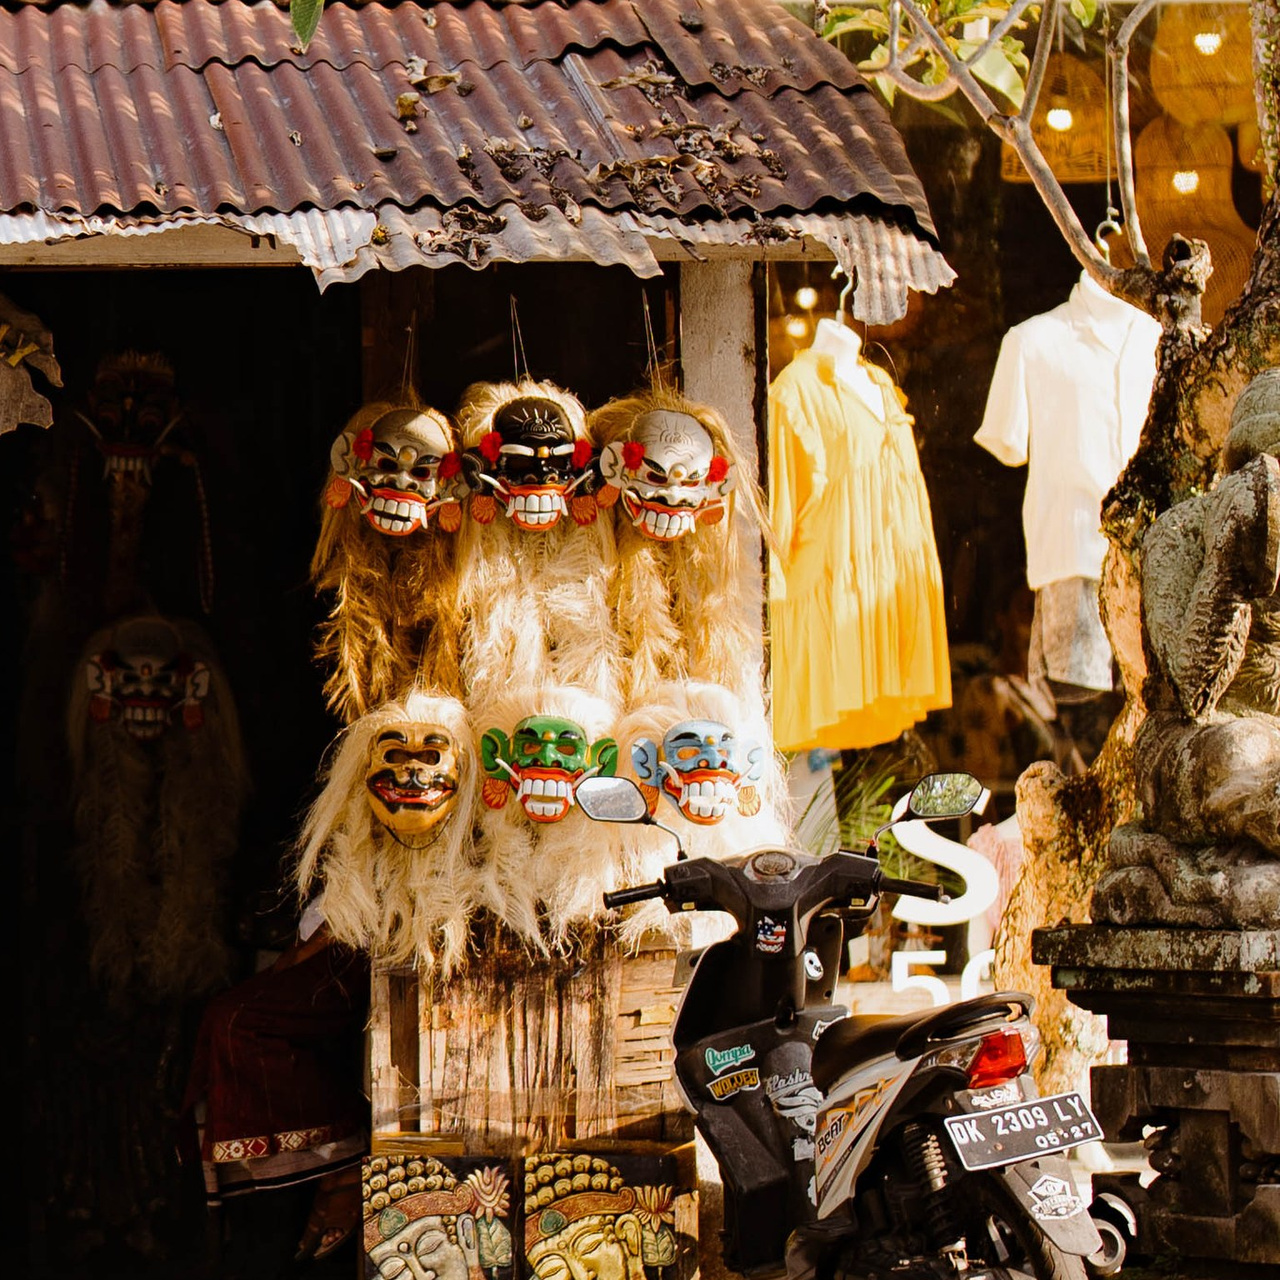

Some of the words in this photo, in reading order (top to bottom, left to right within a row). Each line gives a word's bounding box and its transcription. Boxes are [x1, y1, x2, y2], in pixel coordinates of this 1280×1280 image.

[891, 949, 996, 1008] 5
[950, 1119, 986, 1145] DK
[991, 1106, 1050, 1136] 2309
[1052, 1095, 1084, 1122] LY
